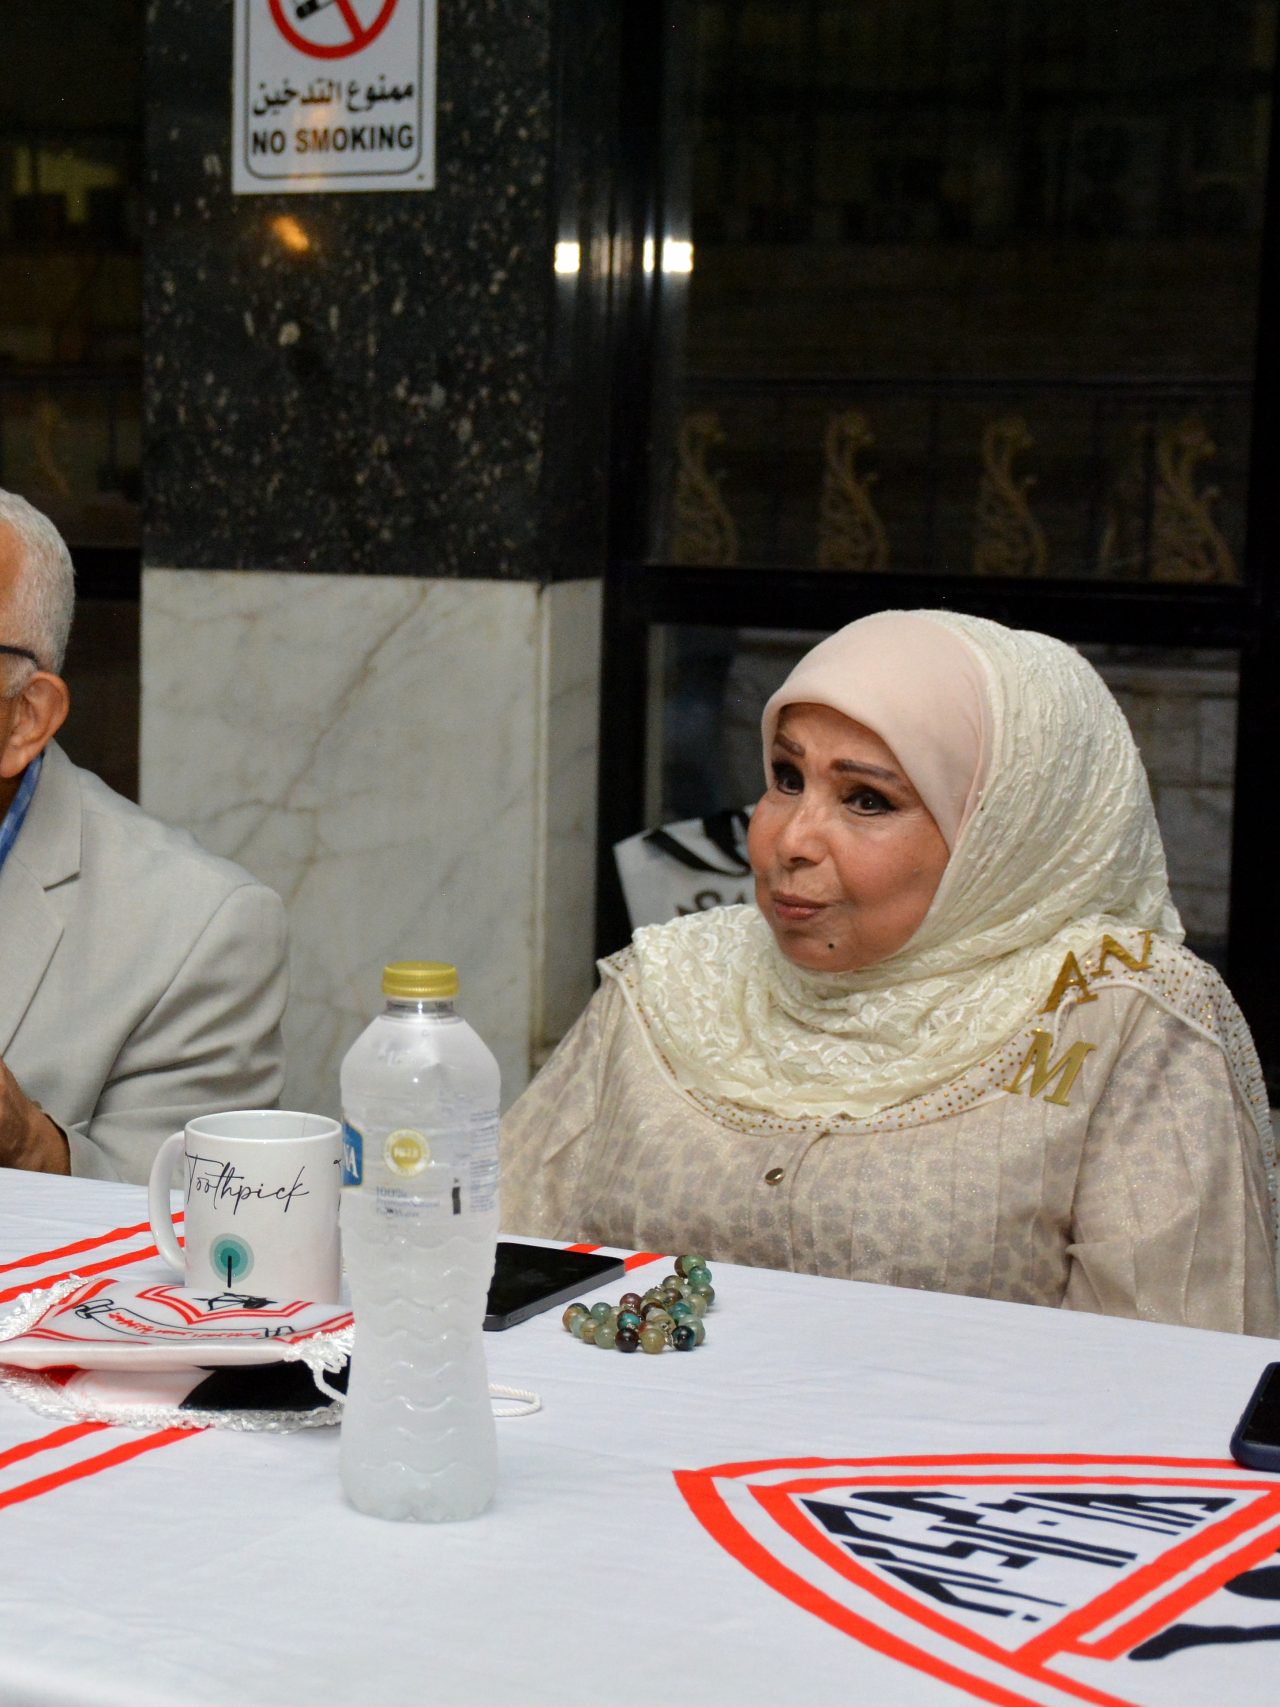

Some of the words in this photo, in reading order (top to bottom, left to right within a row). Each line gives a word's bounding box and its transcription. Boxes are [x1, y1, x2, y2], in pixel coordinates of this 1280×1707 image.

[252, 77, 342, 116] التدخين
[346, 73, 415, 112] ممنوع
[252, 130, 287, 154] NO
[295, 125, 415, 152] SMOKING
[184, 1151, 310, 1216] Toothpick
